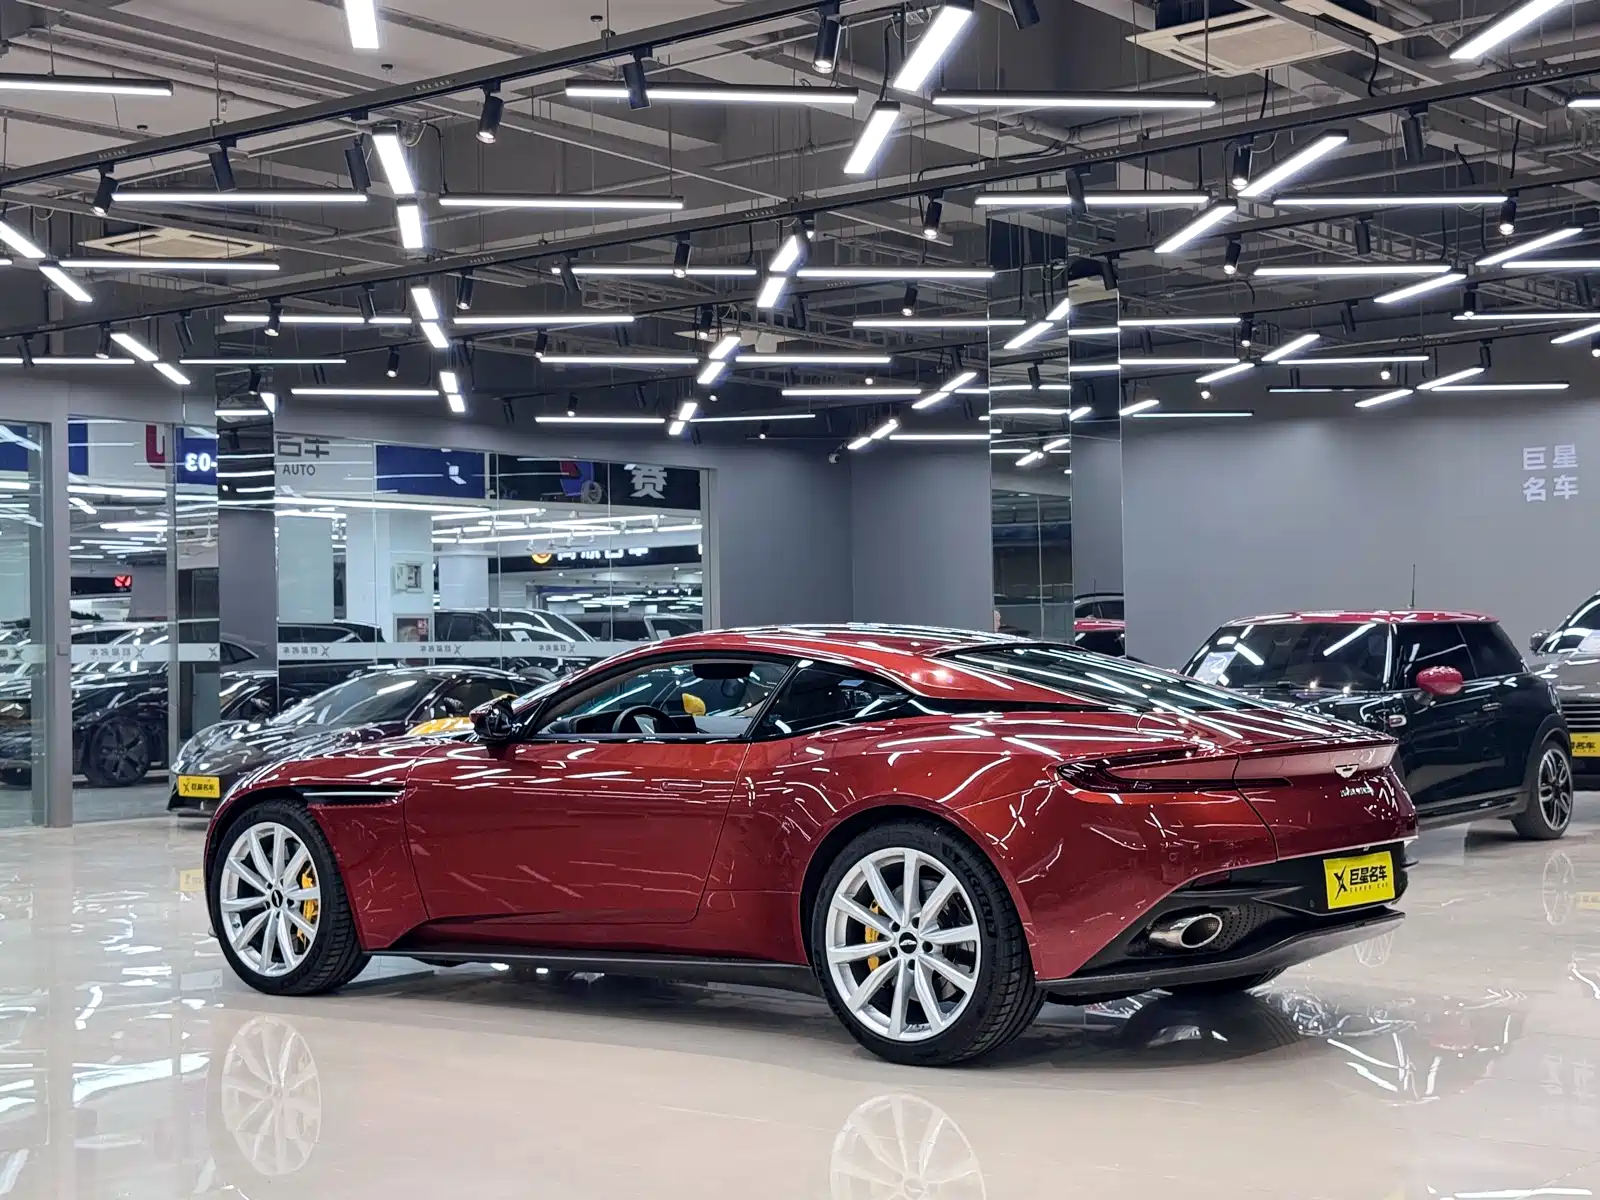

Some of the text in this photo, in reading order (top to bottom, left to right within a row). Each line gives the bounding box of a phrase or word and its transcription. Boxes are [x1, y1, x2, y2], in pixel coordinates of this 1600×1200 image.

[282, 463, 316, 476] AUTO
[1523, 443, 1579, 470] 巨星
[629, 464, 668, 500] 赛
[1522, 474, 1579, 502] 名车
[1350, 864, 1388, 886] 巨星名车
